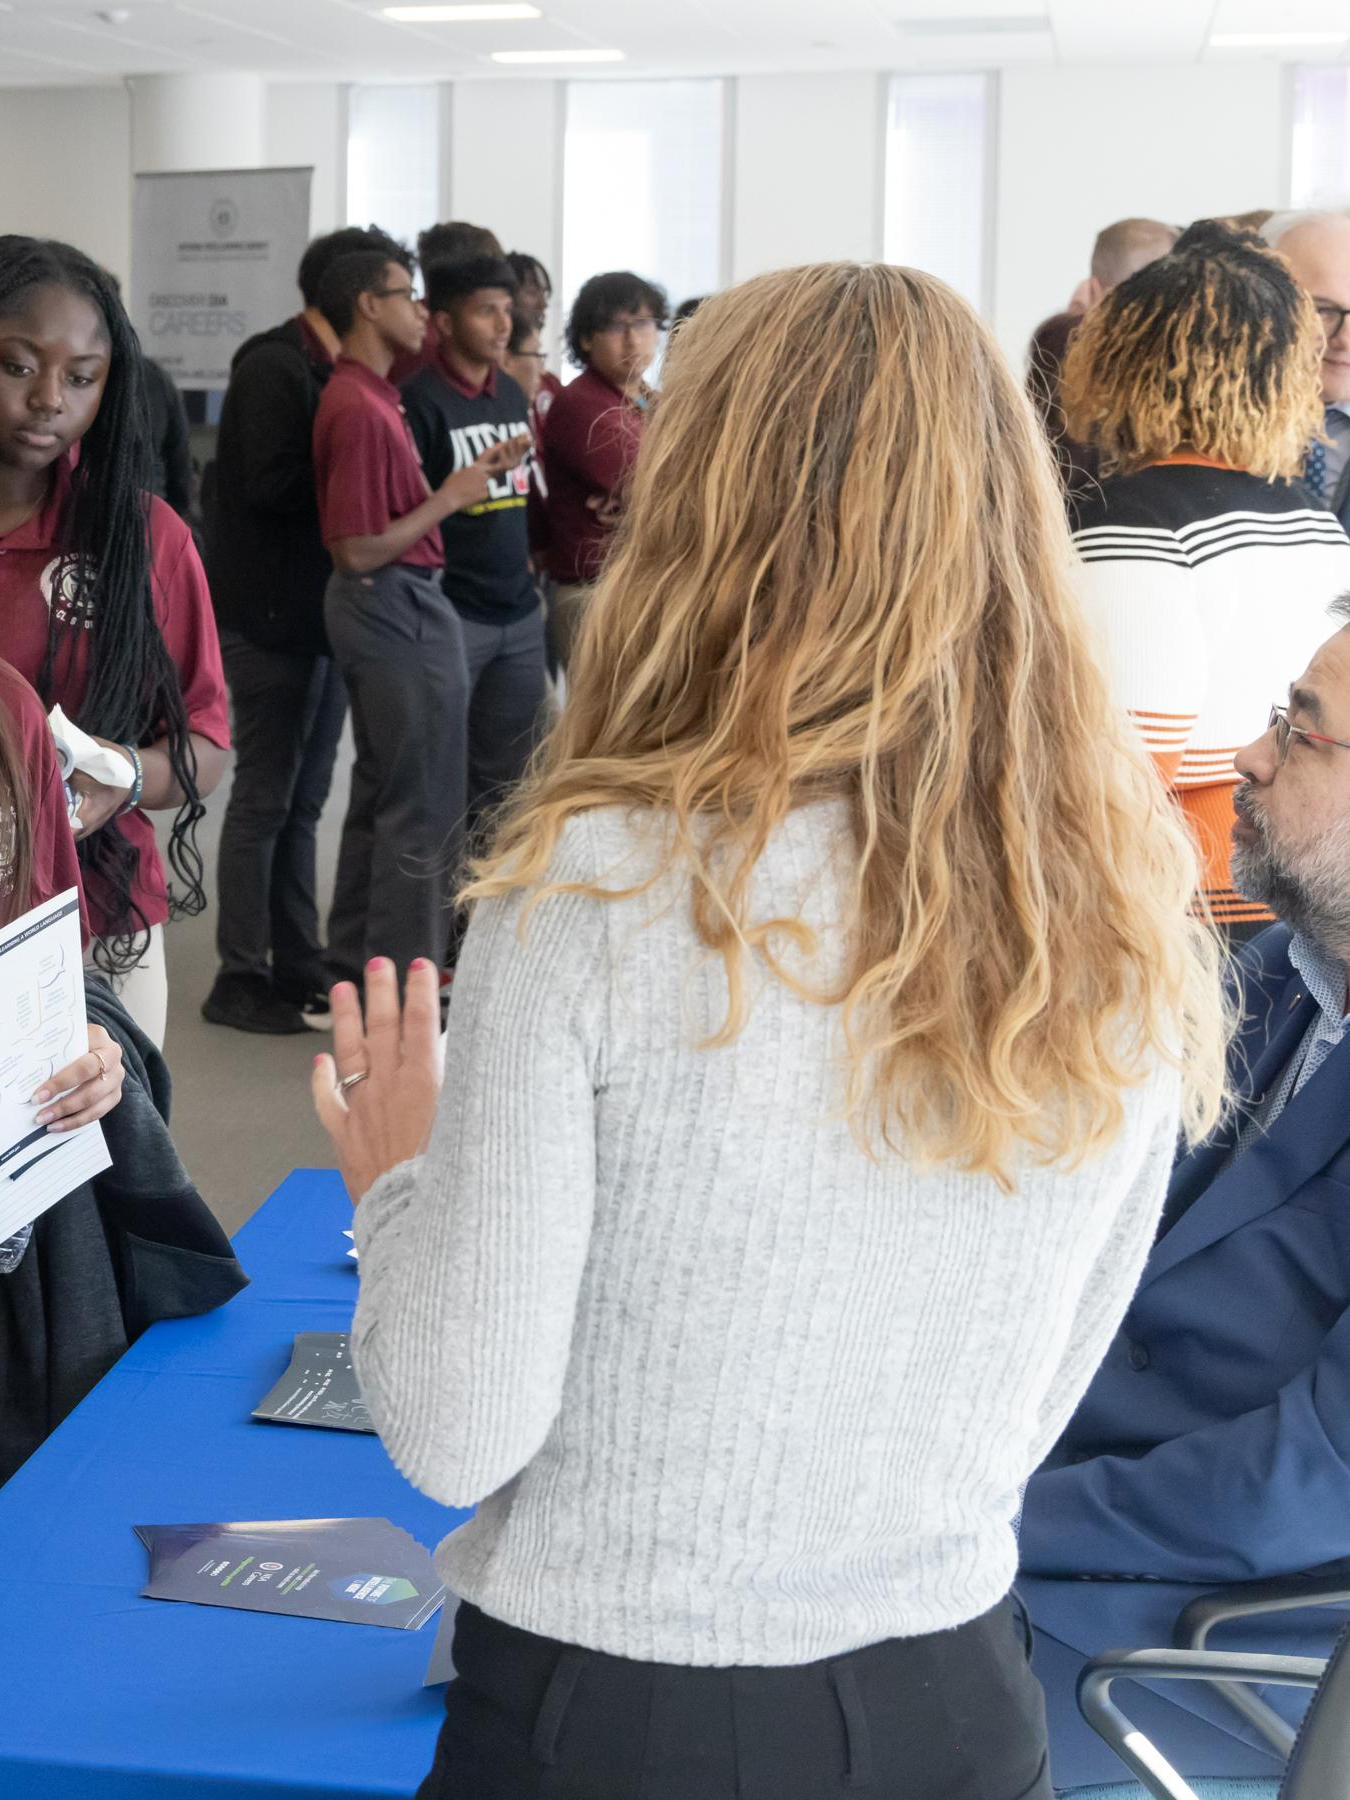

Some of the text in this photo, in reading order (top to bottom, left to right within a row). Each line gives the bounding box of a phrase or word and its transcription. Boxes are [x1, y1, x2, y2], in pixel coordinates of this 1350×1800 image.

[149, 310, 248, 336] CAREERS
[24, 924, 40, 938] WORLD
[39, 910, 64, 928] LANGUAGE
